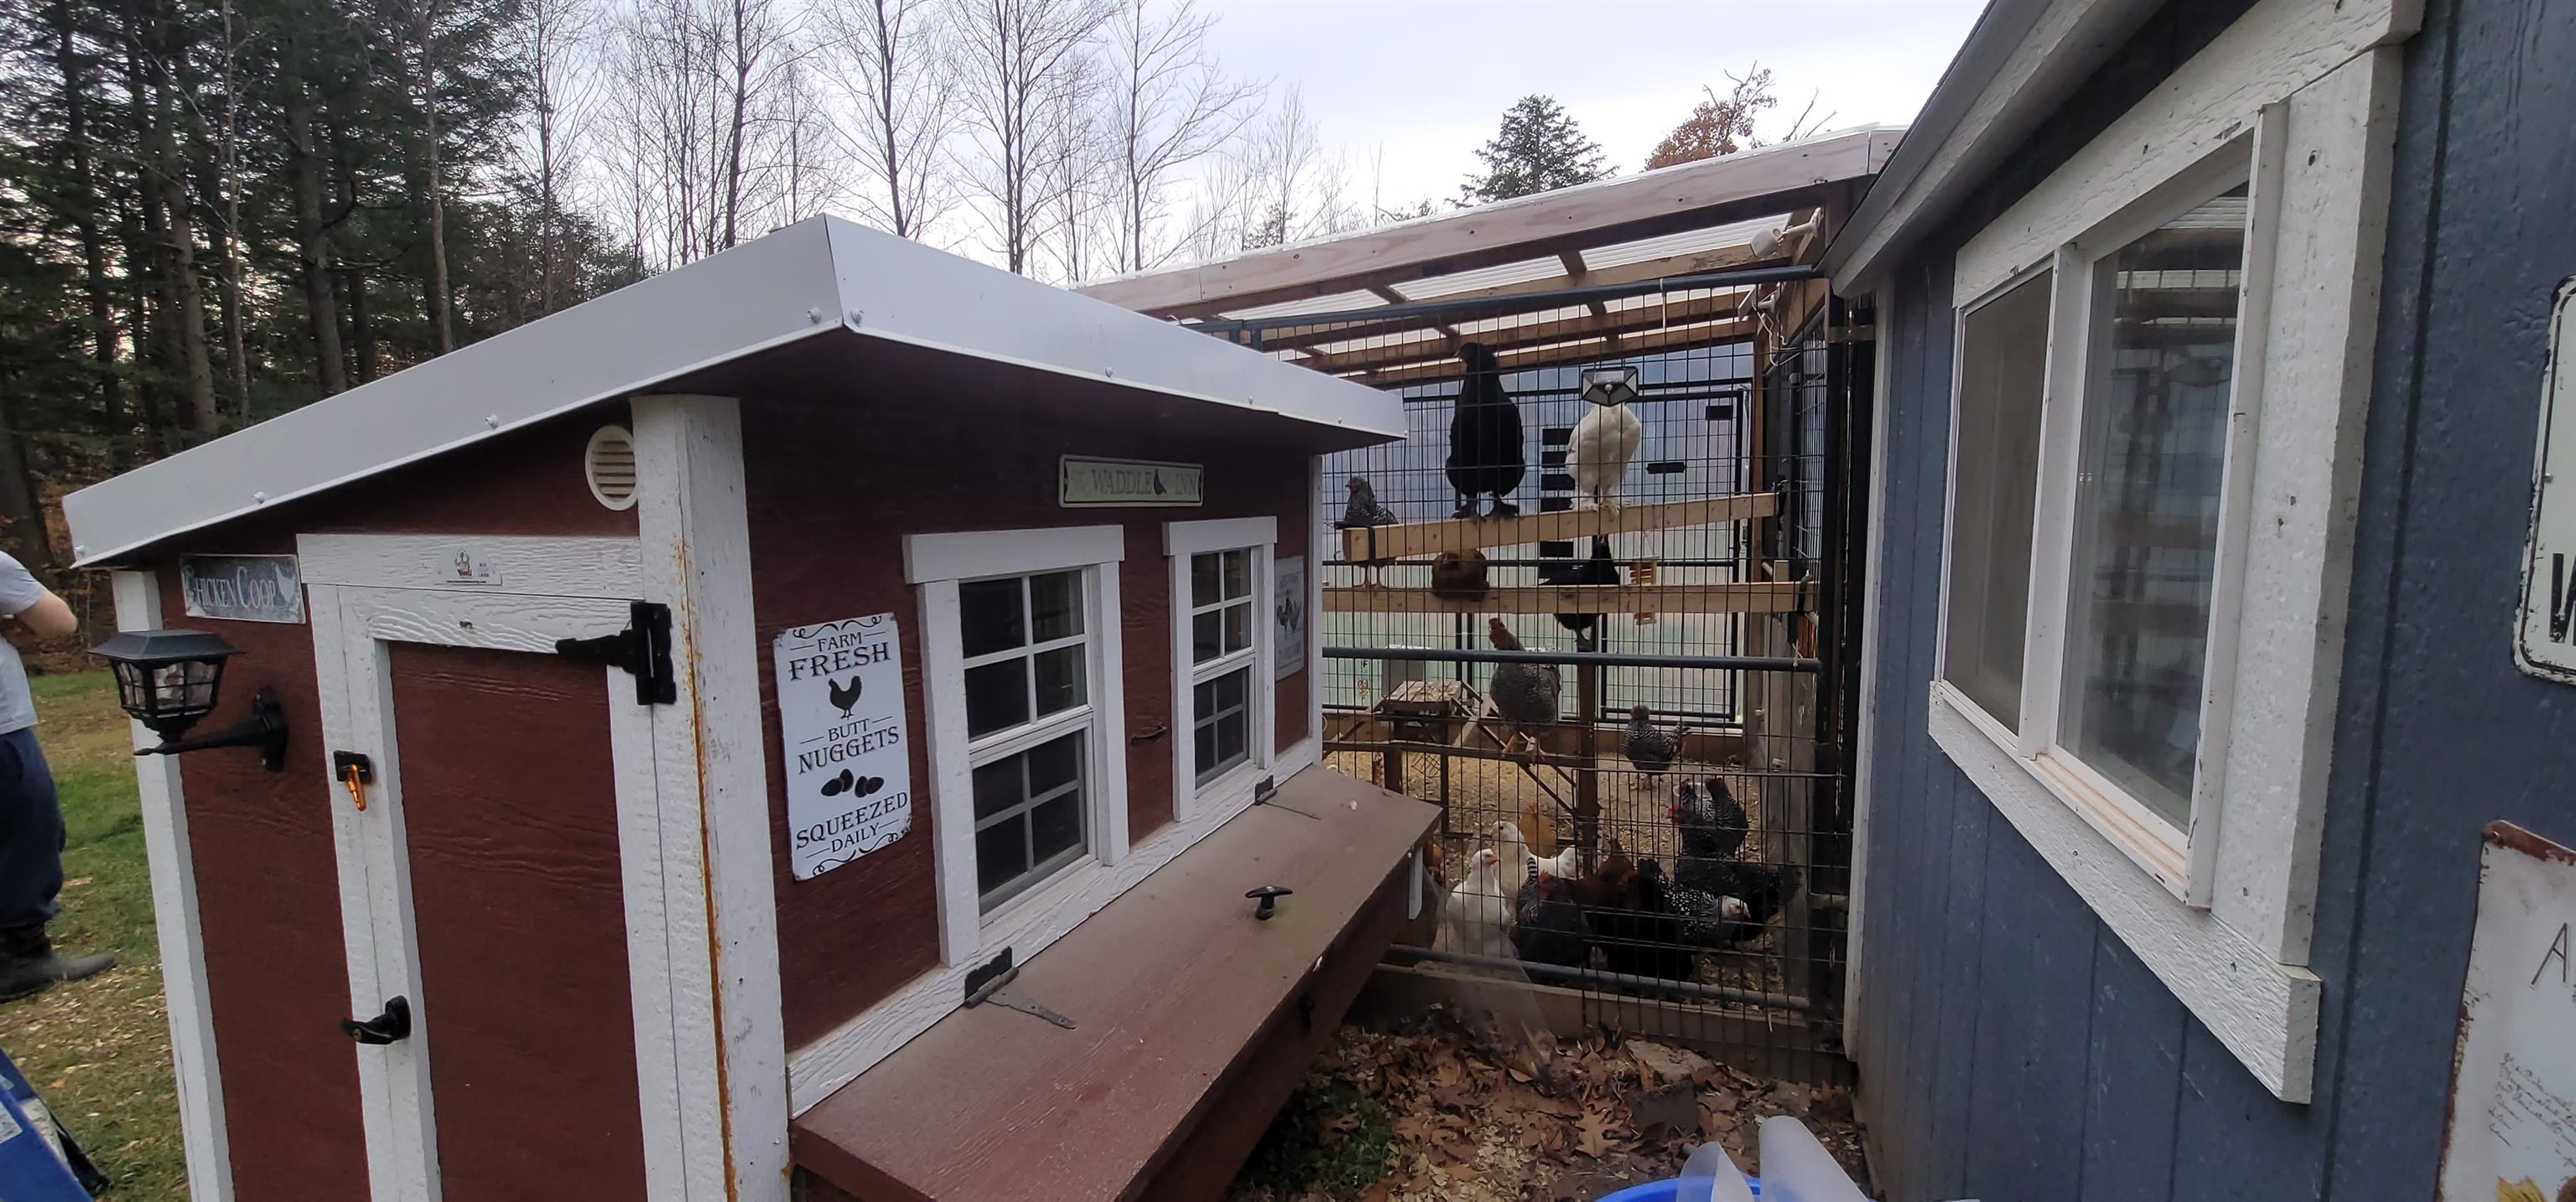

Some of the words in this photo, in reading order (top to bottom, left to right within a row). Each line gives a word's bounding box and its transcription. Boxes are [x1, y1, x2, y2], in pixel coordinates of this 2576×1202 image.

[1092, 469, 1151, 495] WADDLE
[1176, 473, 1197, 495] INN
[818, 632, 863, 652] FARM
[788, 642, 891, 681] FRESH
[828, 718, 870, 743] BUTT
[798, 726, 900, 775] NUGGETS
[797, 791, 908, 850] SQUEEZED
[830, 822, 880, 853] DAILY
